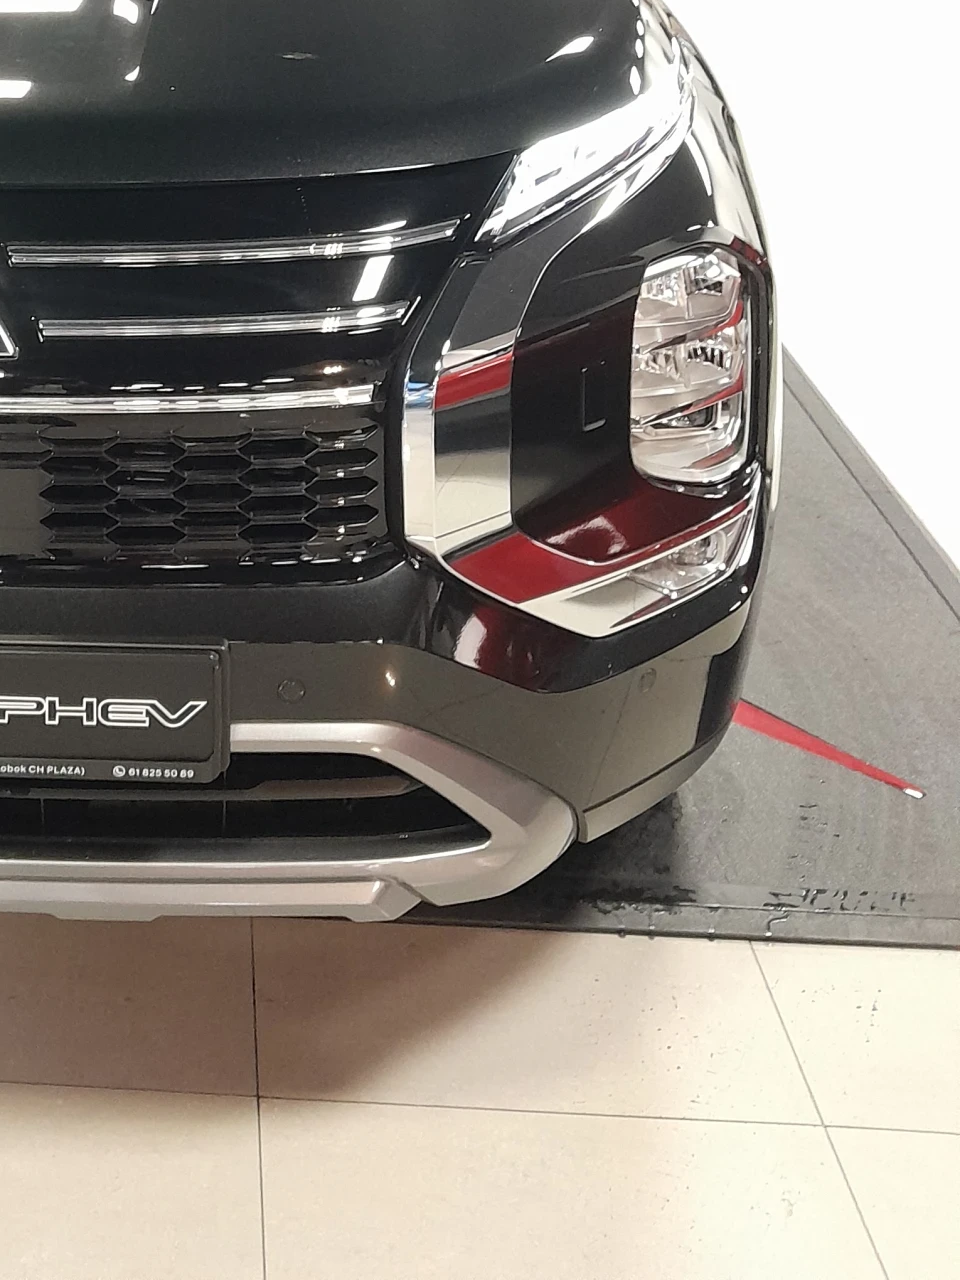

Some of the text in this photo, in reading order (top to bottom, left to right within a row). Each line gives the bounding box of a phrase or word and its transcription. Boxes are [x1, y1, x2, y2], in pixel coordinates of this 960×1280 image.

[28, 765, 44, 775] CH
[46, 766, 85, 776] PLAZA)
[128, 767, 140, 777] 61
[164, 768, 178, 778] 50
